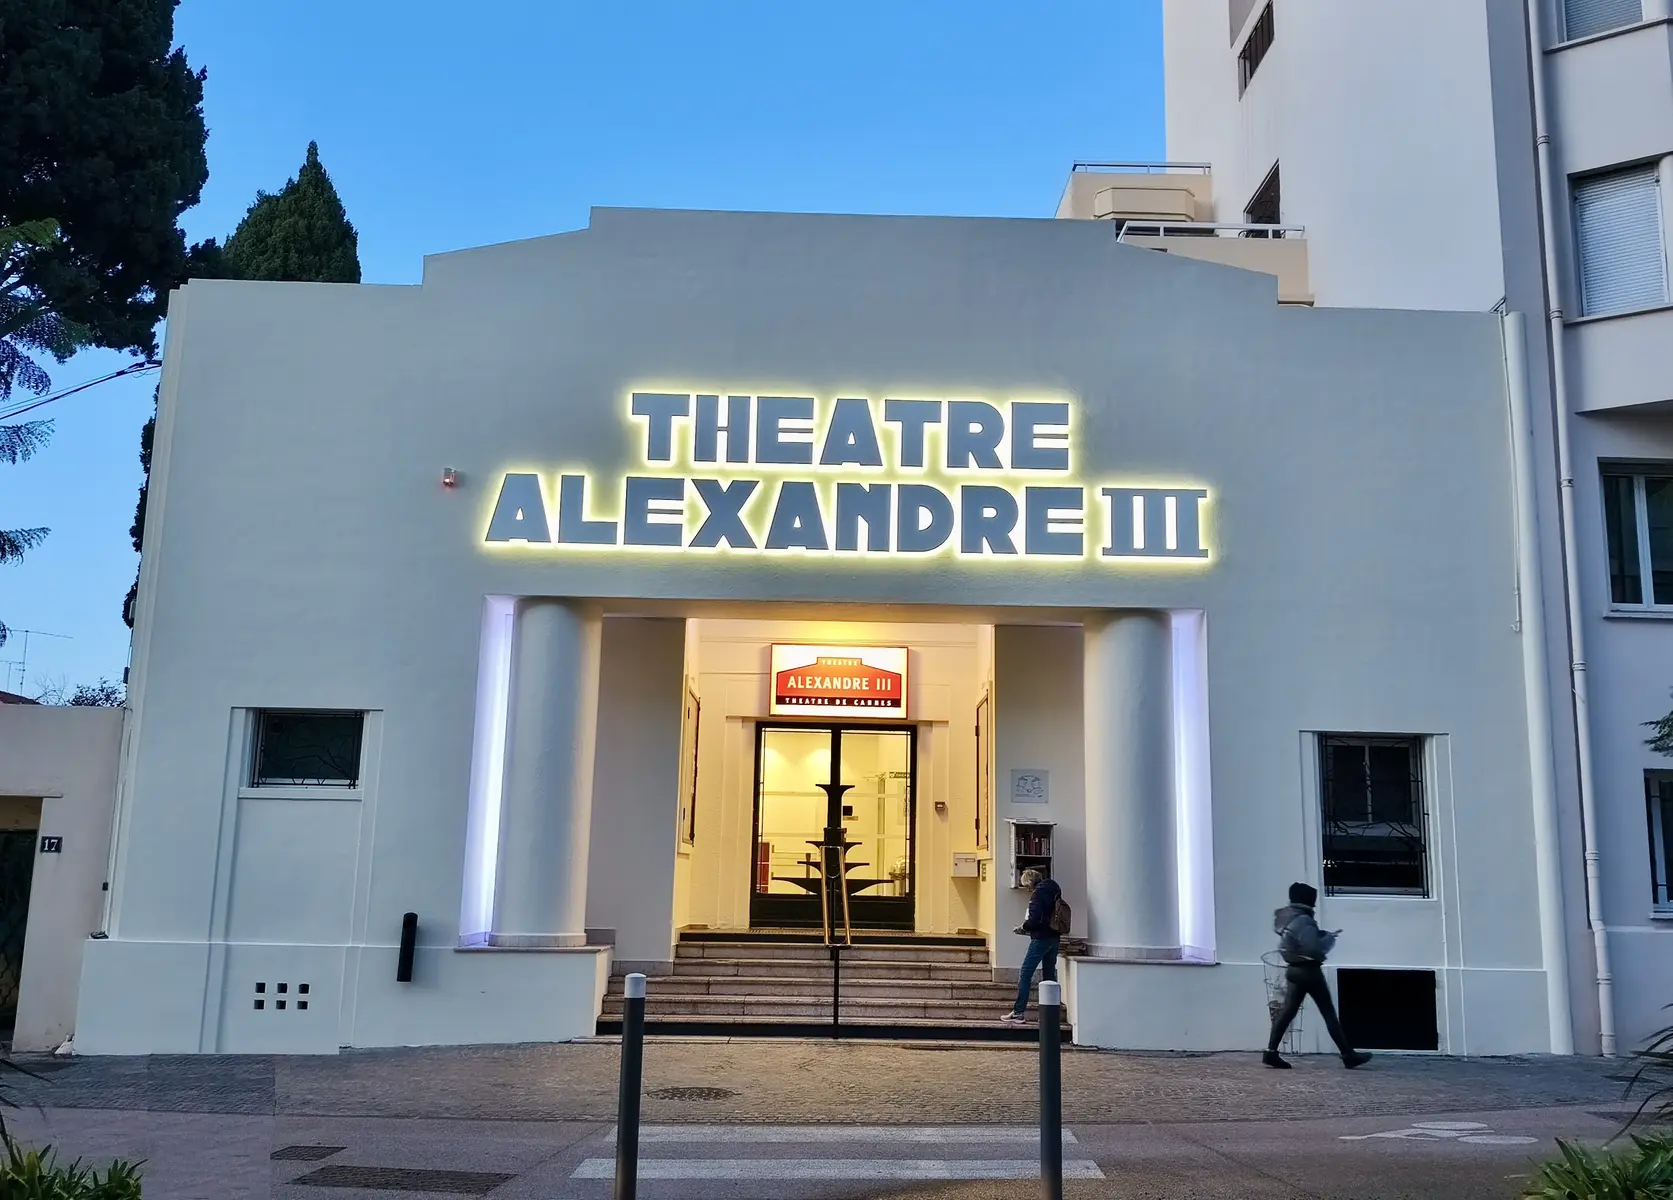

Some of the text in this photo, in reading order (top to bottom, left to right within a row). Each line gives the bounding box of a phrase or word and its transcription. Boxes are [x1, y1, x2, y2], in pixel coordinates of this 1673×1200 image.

[632, 393, 1069, 470] THEATRE
[485, 474, 1209, 559] ALEXANDRE III
[787, 676, 892, 691] ALEXANDRE III
[785, 697, 892, 707] THEATRE DE CANNES
[43, 838, 59, 851] 17
